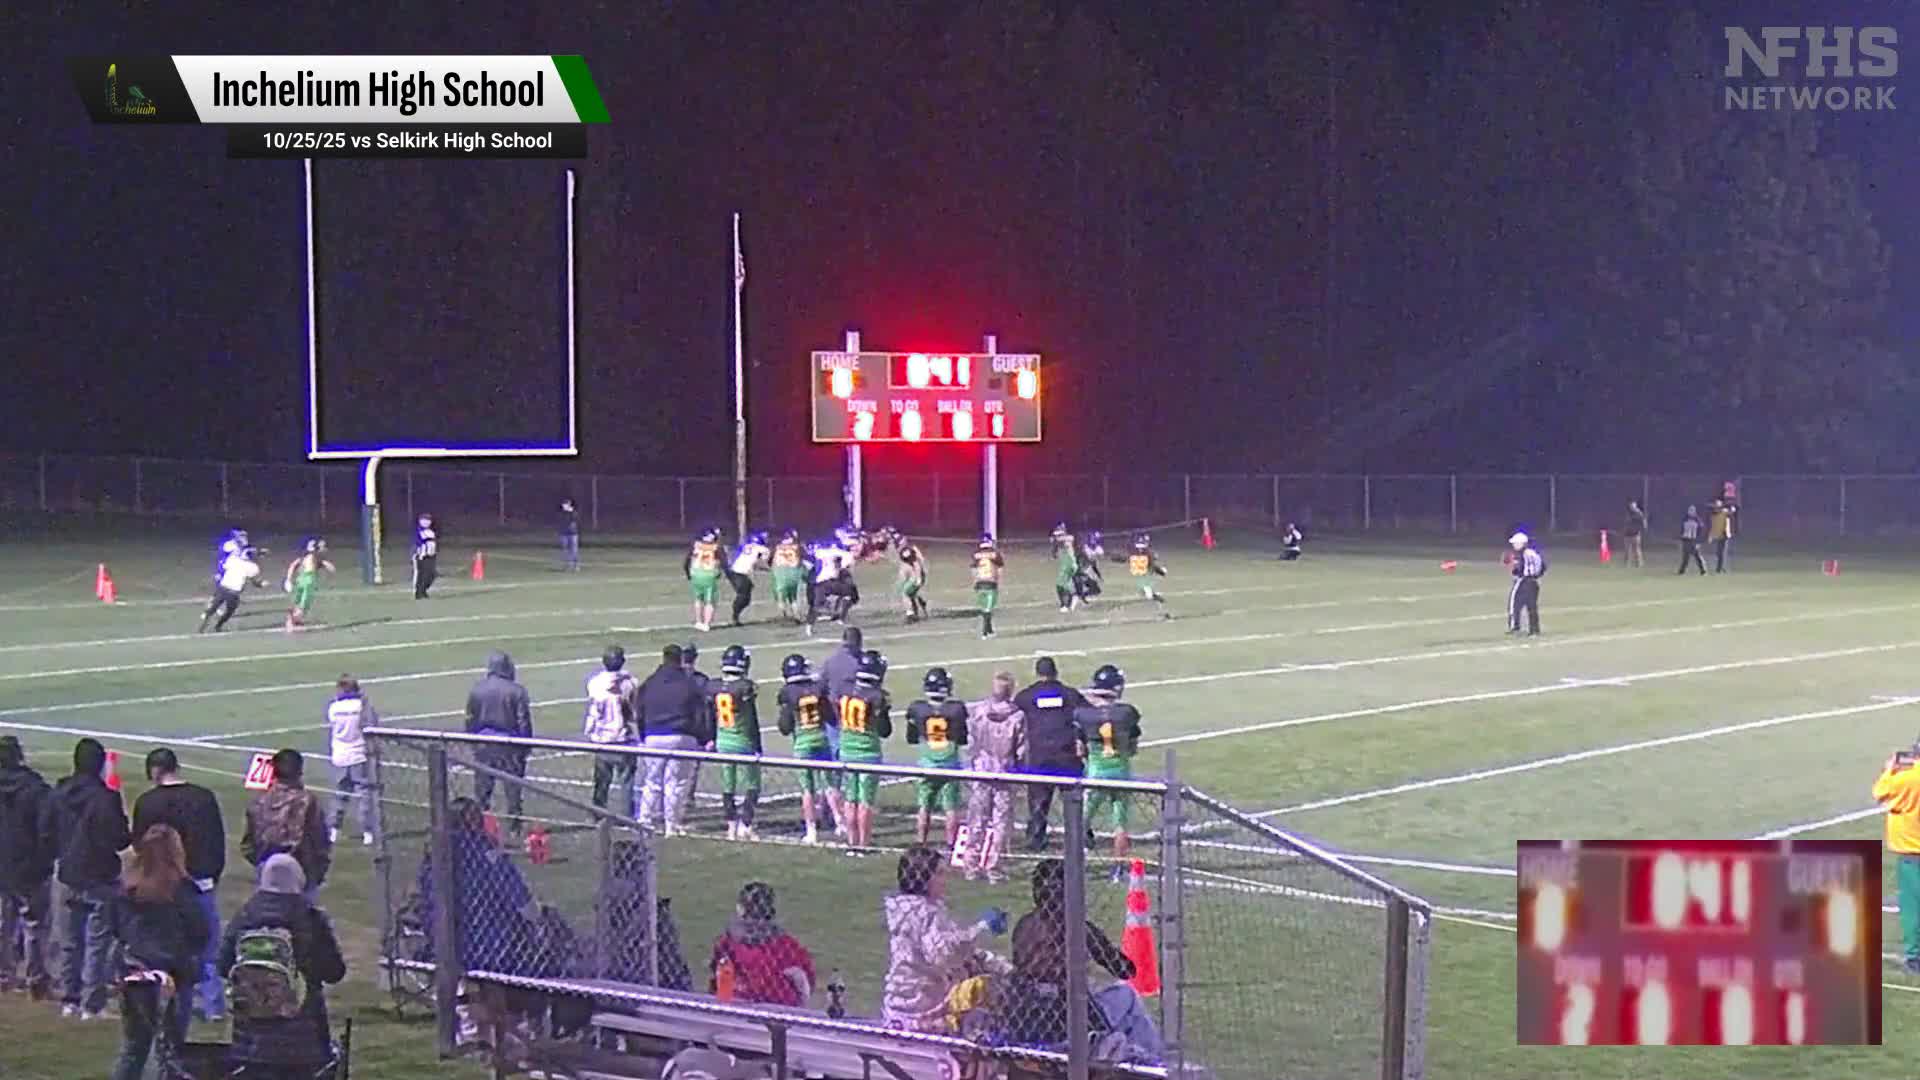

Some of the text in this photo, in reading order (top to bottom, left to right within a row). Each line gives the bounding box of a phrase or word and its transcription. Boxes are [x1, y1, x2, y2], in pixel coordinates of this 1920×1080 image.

[820, 355, 860, 371] HOME
[992, 355, 1033, 373] GUEST
[847, 400, 878, 413] DOWN
[715, 693, 736, 728] 8
[840, 694, 868, 733] 10
[1098, 721, 1115, 756] 1
